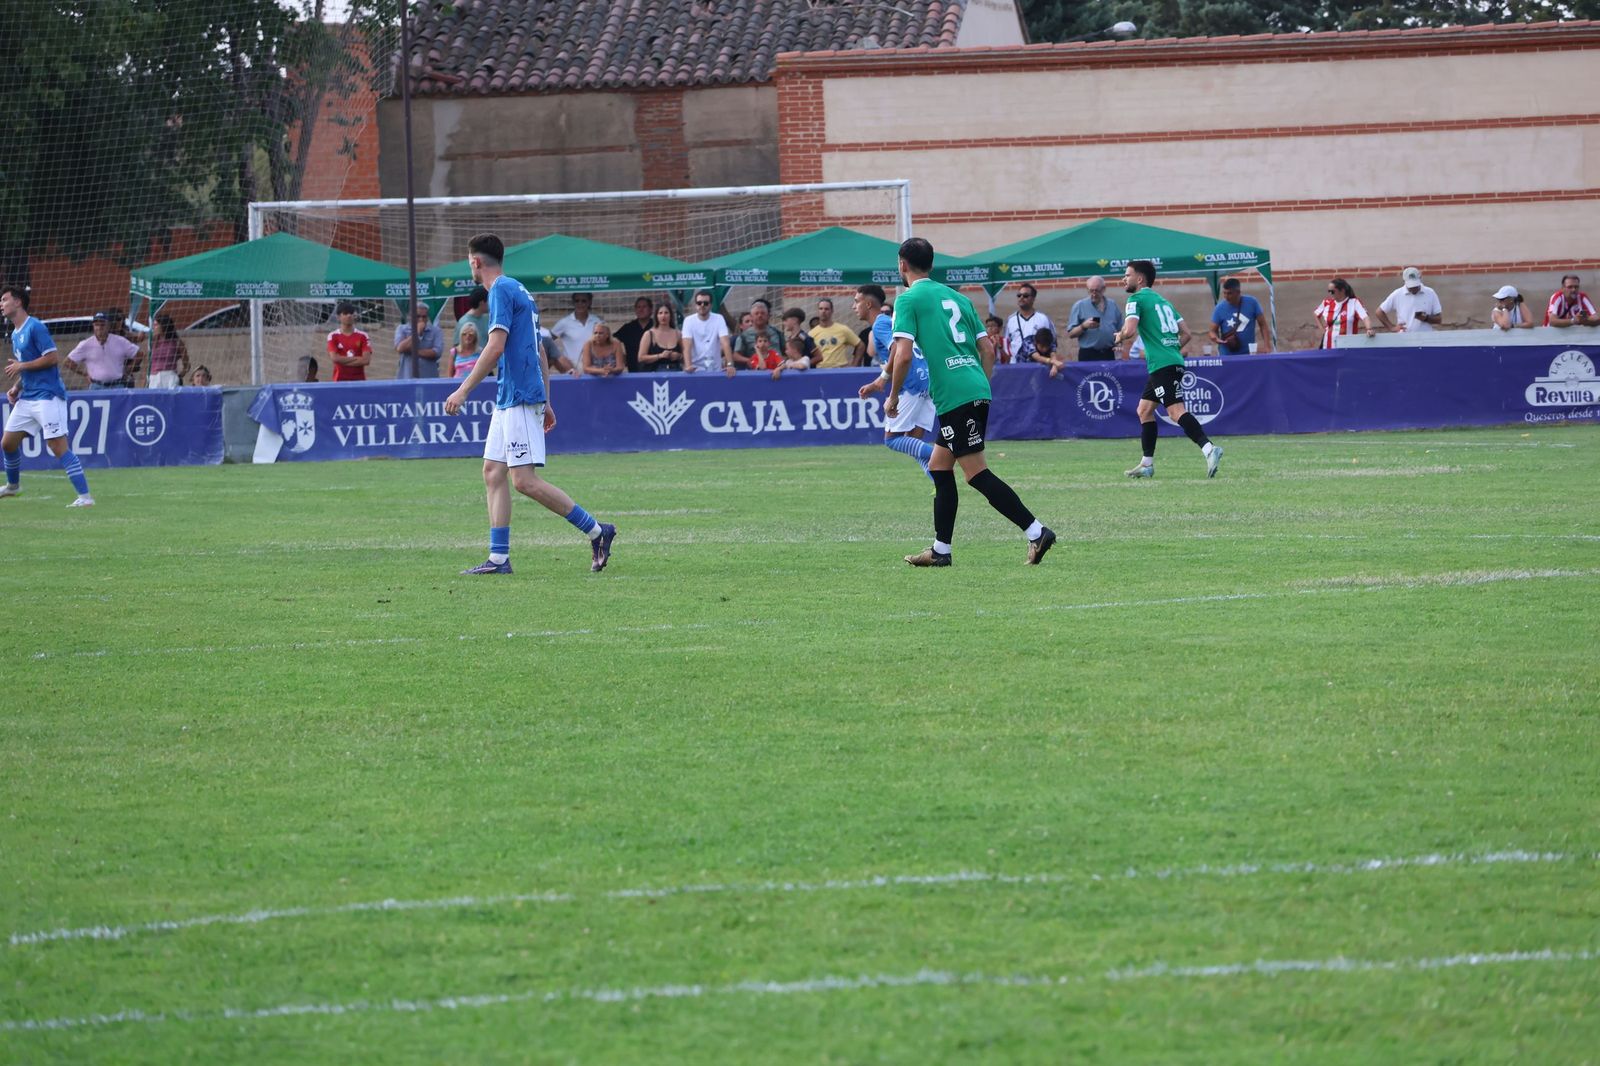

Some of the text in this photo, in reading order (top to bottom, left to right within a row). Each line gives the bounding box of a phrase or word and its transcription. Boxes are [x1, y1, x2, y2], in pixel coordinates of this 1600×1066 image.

[1205, 251, 1258, 261] CAJA RURAL
[1012, 263, 1064, 273] CAJA RURAL
[556, 275, 610, 285] CAJA RURAL
[653, 272, 706, 282] CAJA RURAL
[941, 299, 967, 343] 2
[1154, 303, 1179, 334] 18
[1198, 359, 1223, 367] OFICIAL
[1087, 380, 1115, 413] DG
[1183, 387, 1212, 401] rella
[1535, 386, 1594, 404] Revilla
[332, 400, 496, 420] AYUNTAMINTO
[1184, 400, 1210, 413] licia
[135, 415, 155, 425] RF
[700, 397, 886, 435] CAJA RUR
[1524, 411, 1565, 423] Queseros
[1567, 406, 1593, 419] desde
[135, 426, 155, 436] EF
